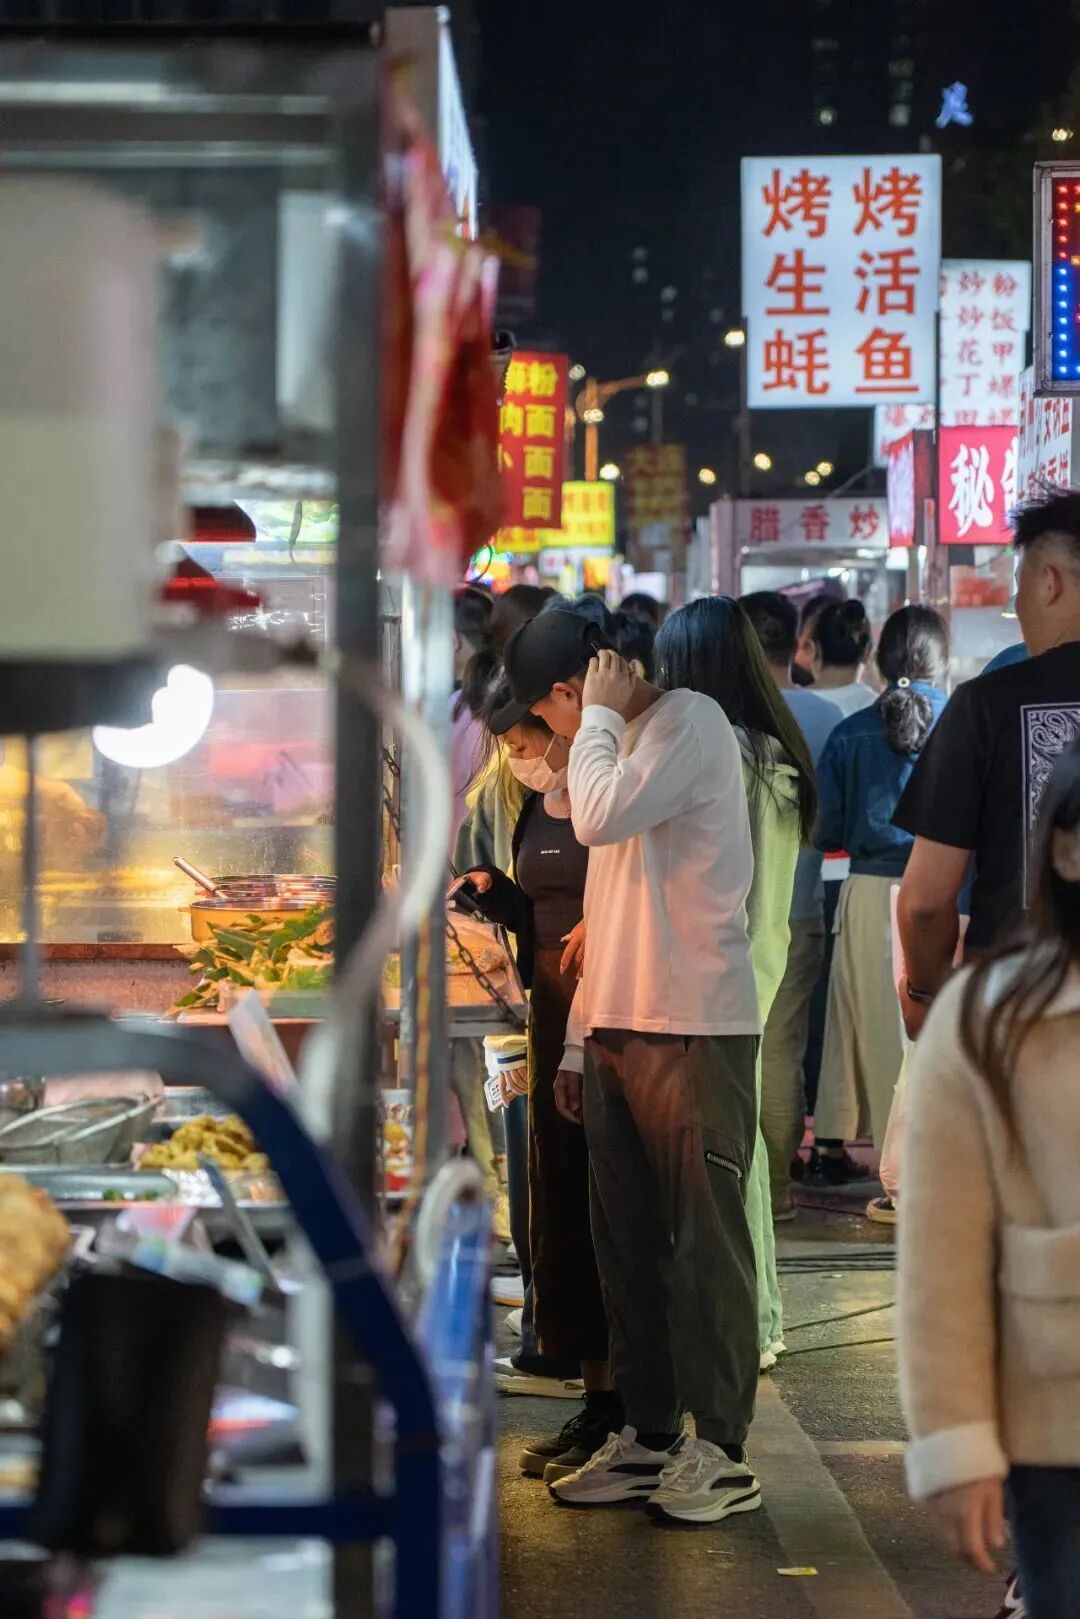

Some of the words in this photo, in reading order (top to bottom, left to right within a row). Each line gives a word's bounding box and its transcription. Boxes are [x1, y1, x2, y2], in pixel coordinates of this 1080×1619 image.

[762, 168, 831, 395] 烤生蚝
[853, 167, 922, 394] 烤活鱼
